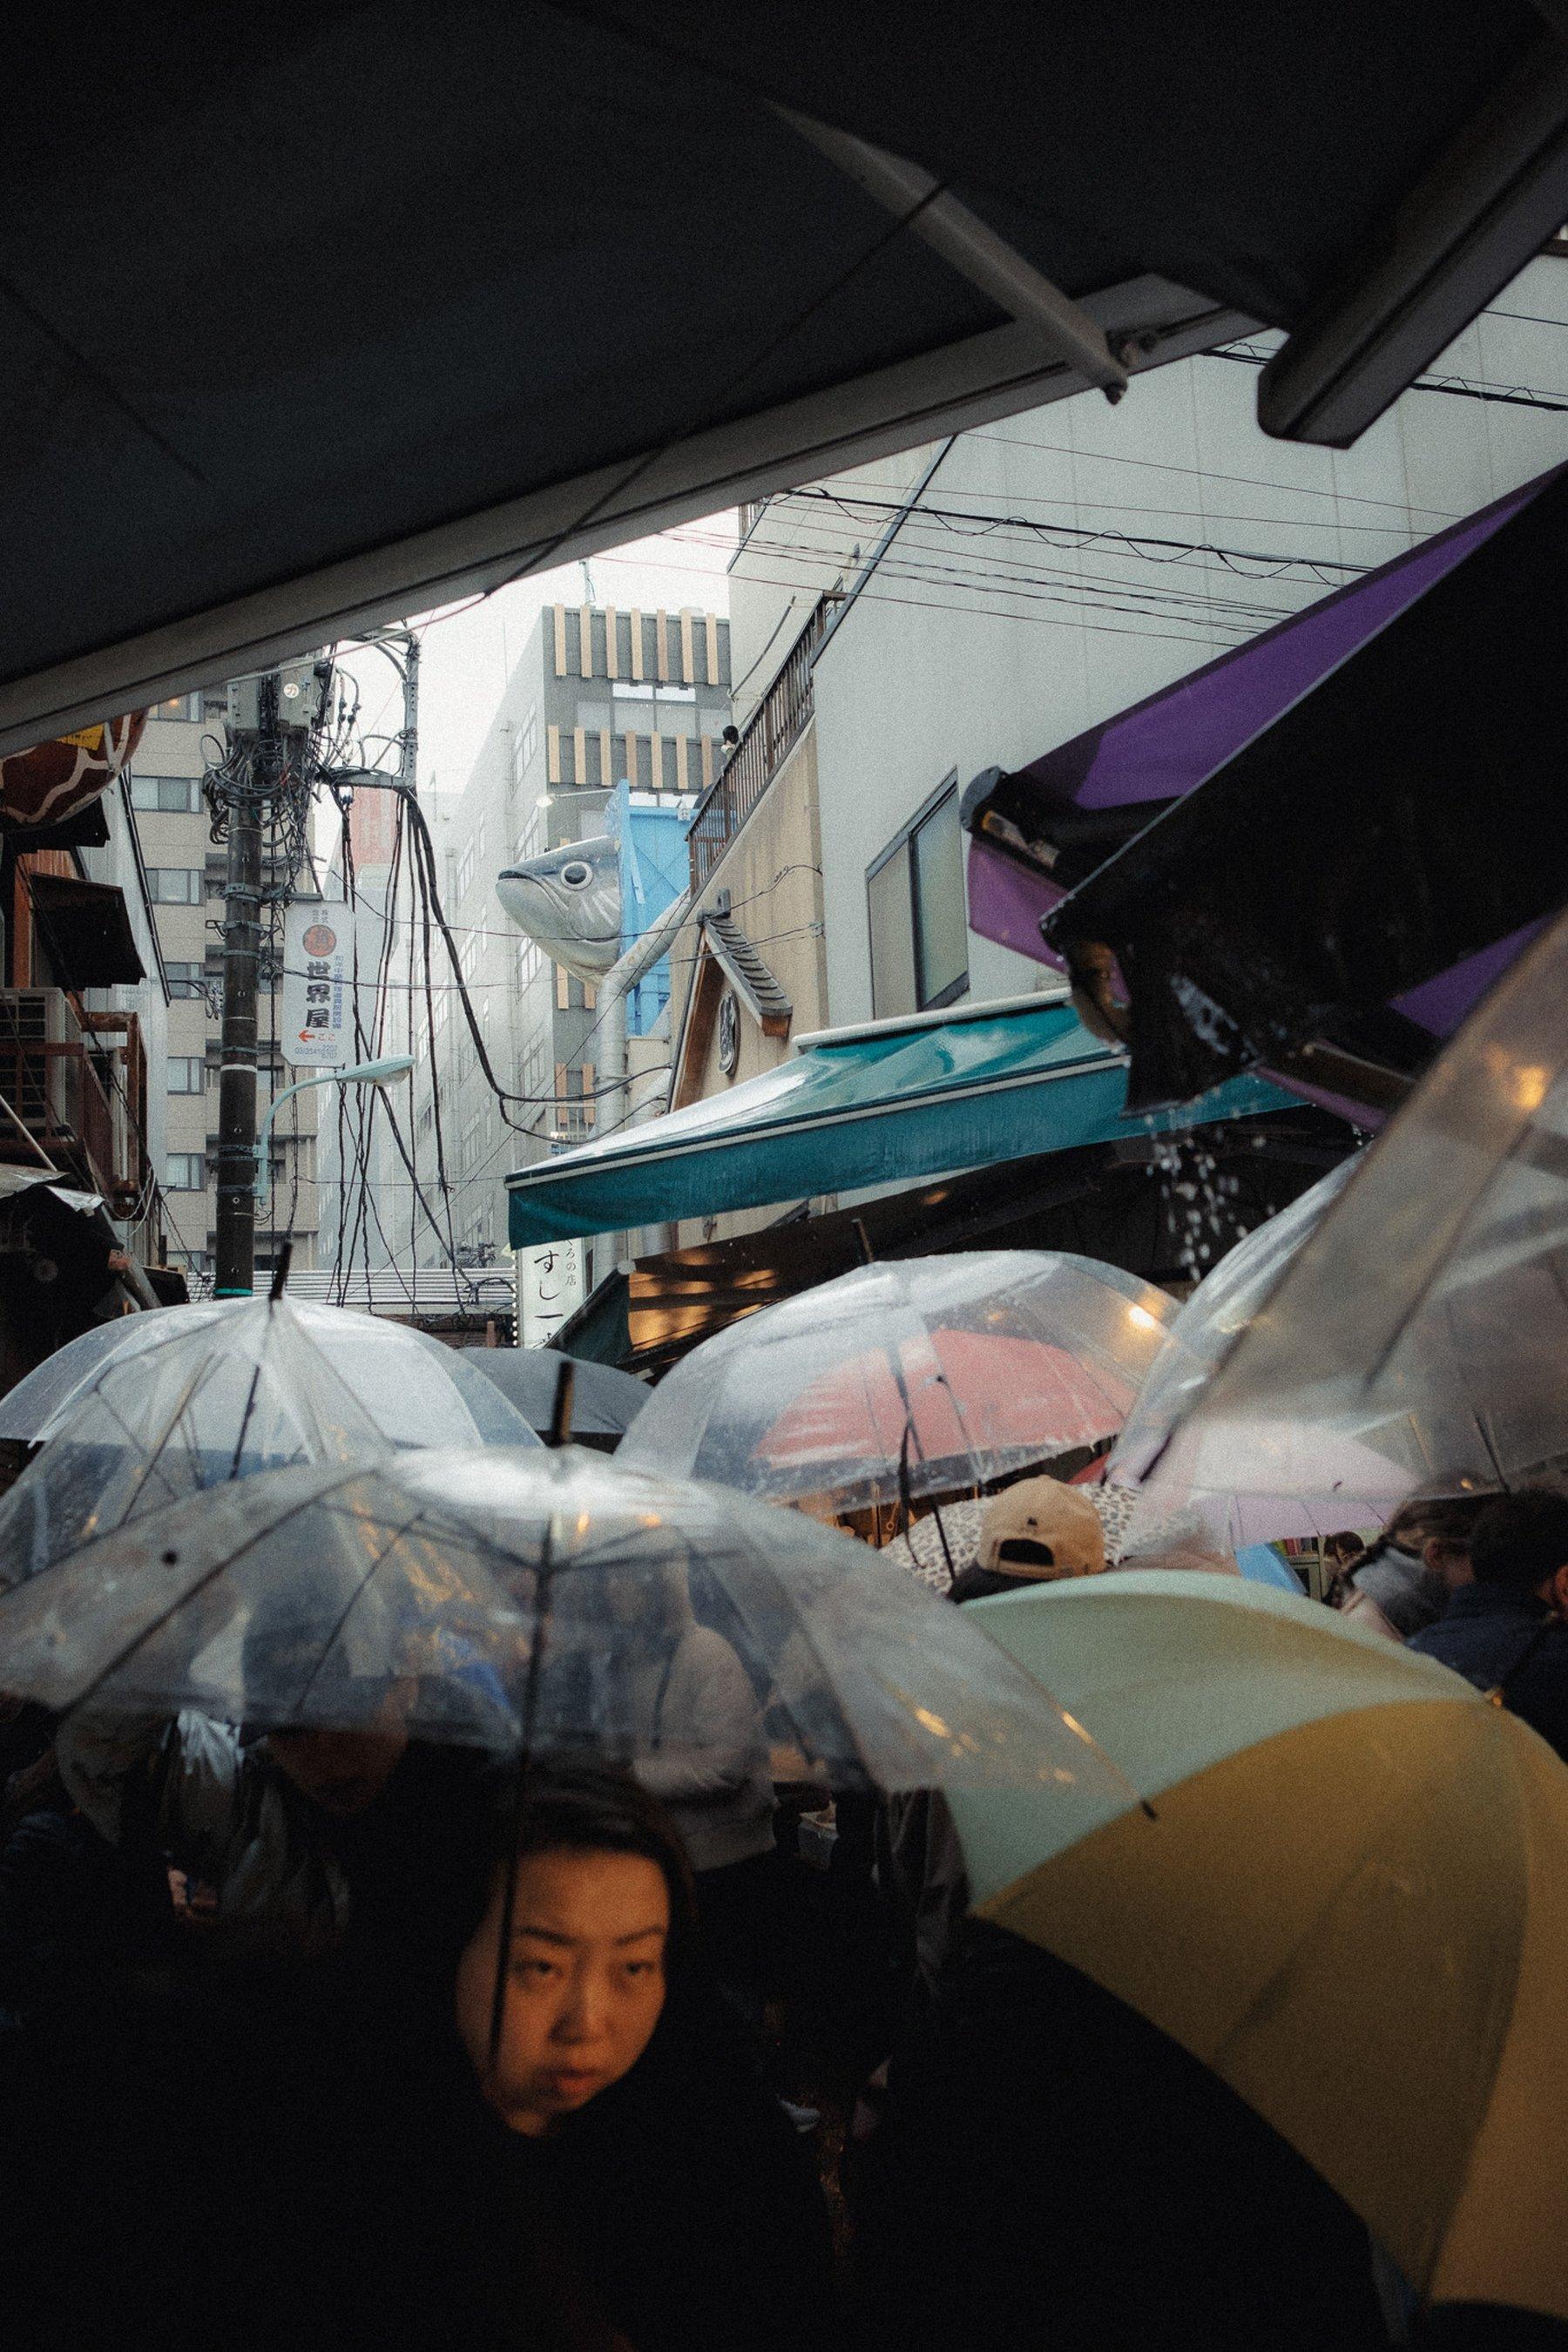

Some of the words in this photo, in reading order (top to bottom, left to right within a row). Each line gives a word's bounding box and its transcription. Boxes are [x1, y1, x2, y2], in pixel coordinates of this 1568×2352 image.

[306, 961, 331, 1029] 世界屋
[317, 1033, 335, 1042] ここ
